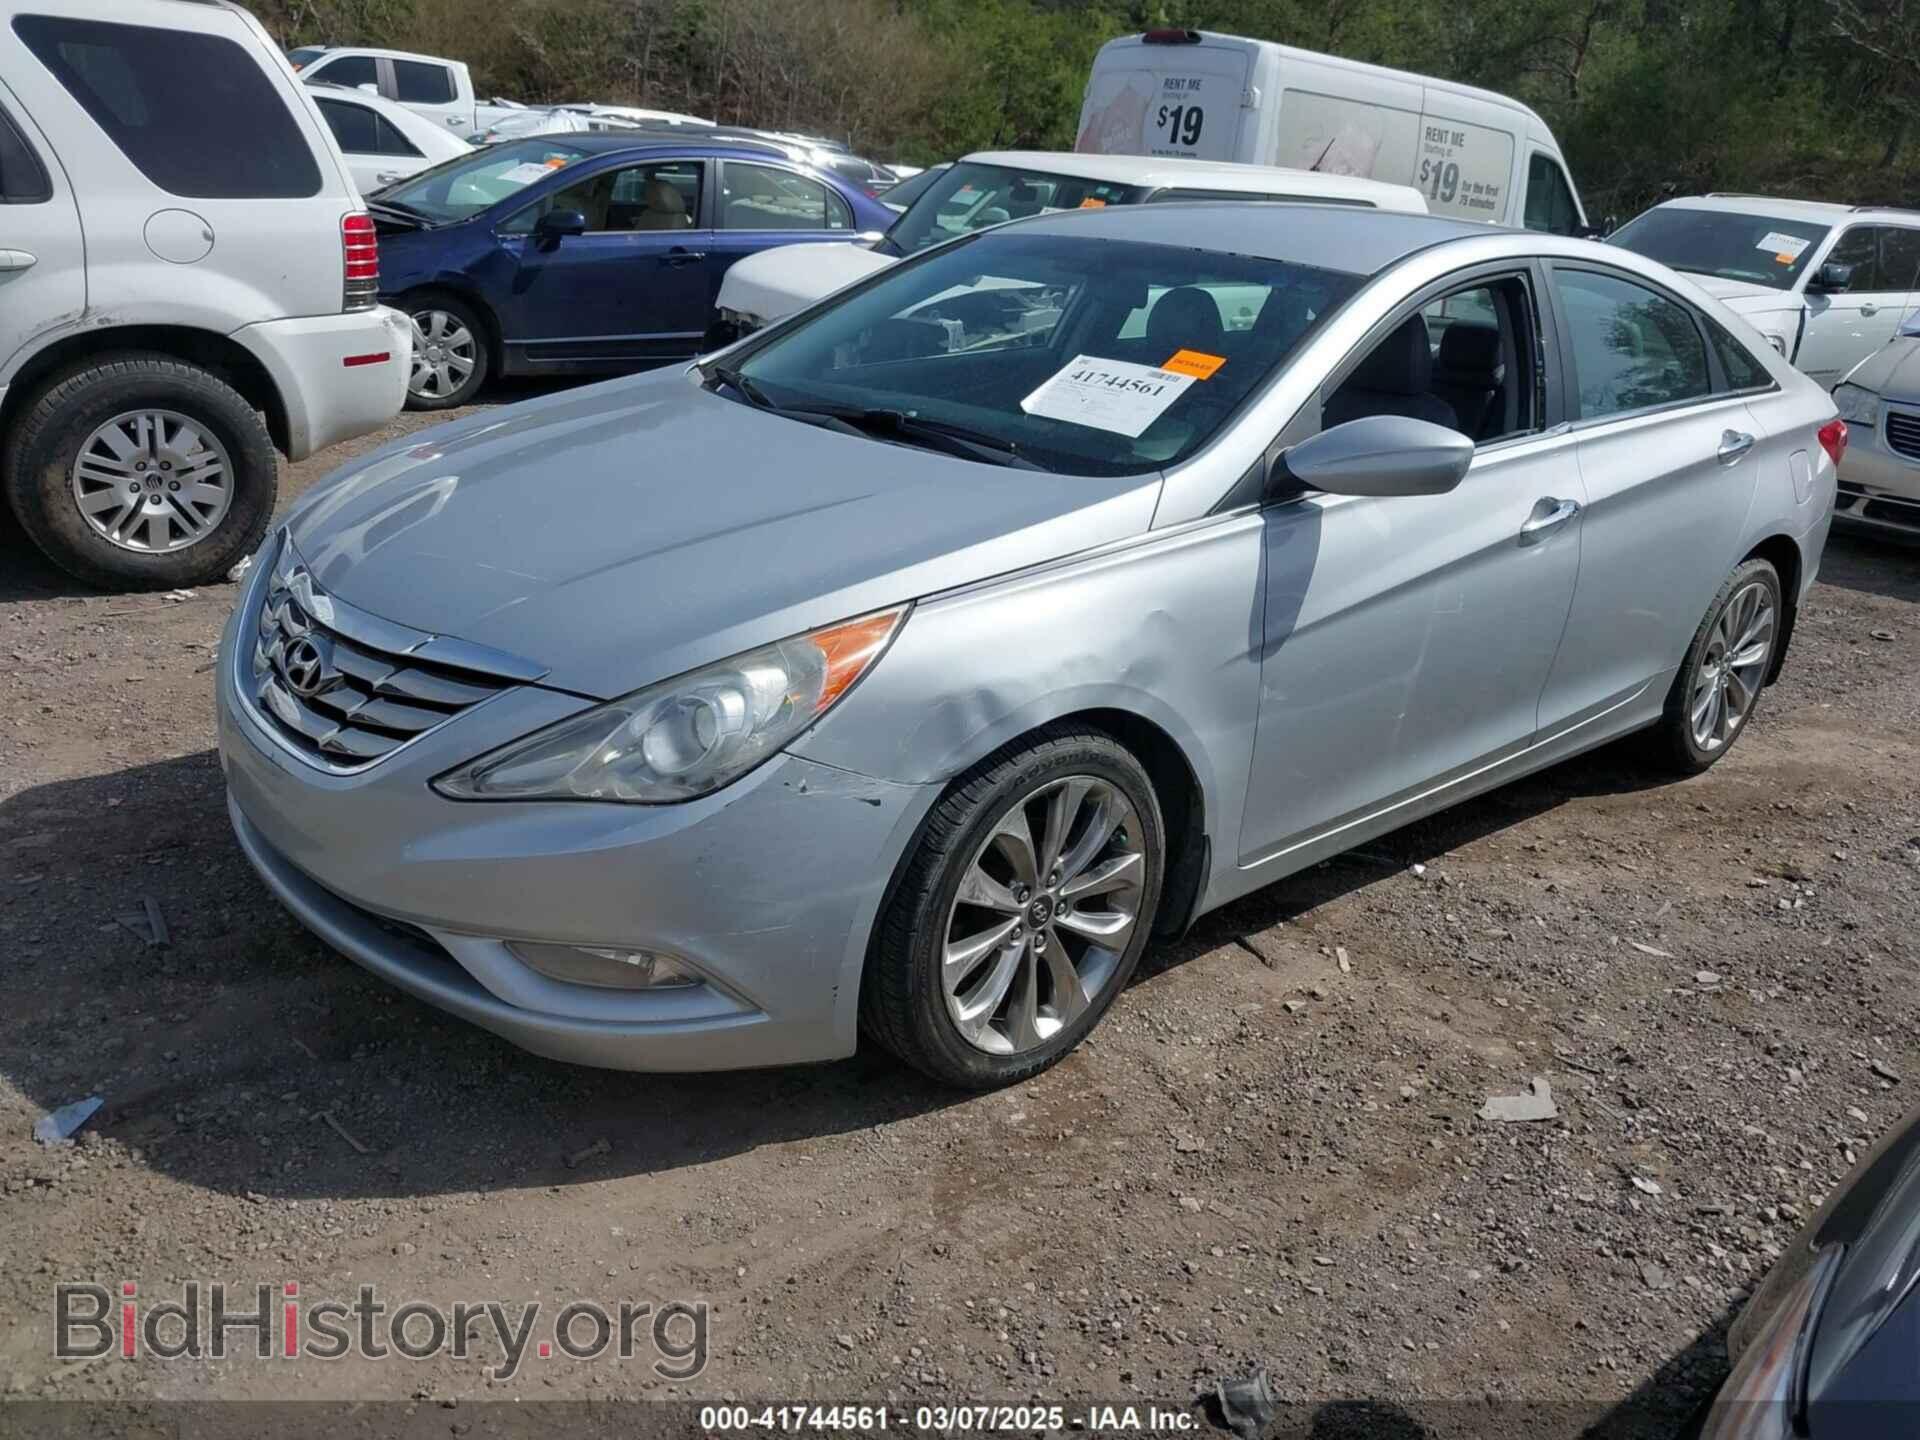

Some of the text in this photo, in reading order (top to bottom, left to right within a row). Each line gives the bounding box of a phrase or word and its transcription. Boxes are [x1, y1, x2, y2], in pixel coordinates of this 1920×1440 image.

[1163, 78, 1201, 91] RENT ME
[1157, 105, 1203, 146] $19
[1425, 126, 1464, 147] RENT ME
[1420, 158, 1459, 203] $19
[1473, 181, 1483, 194] the
[1485, 184, 1498, 197] first
[1469, 198, 1495, 210] minutes
[1071, 370, 1164, 396] 41744561
